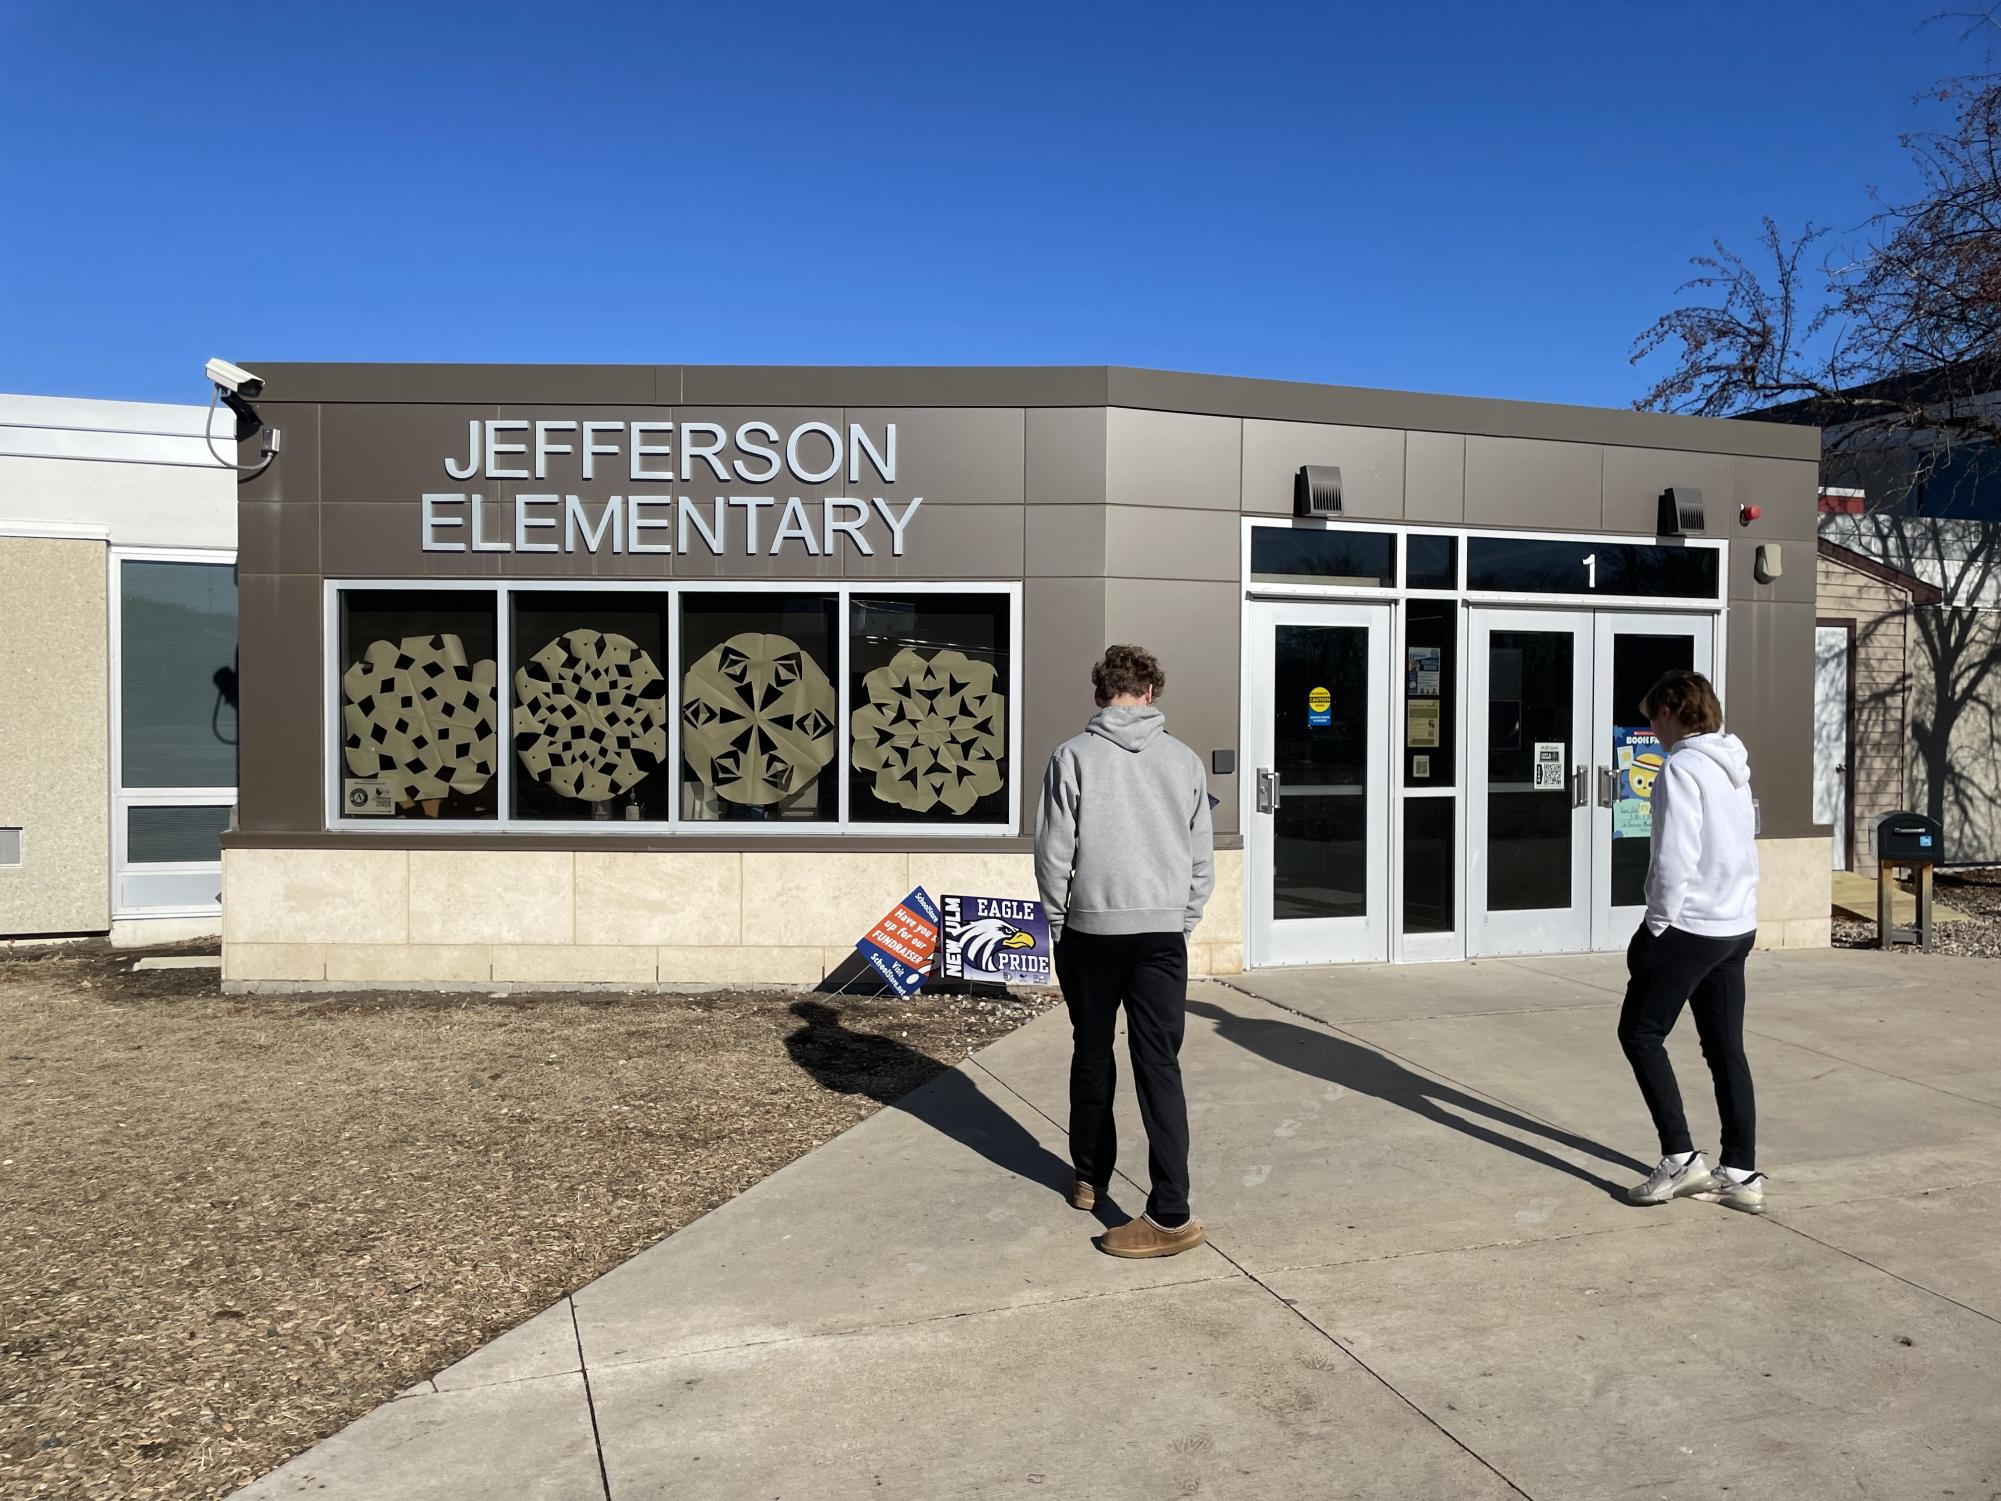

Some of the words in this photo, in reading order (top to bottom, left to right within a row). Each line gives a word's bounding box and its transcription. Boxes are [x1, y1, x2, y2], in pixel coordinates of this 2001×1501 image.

[445, 420, 896, 483] JEFFERSON
[422, 494, 923, 556] ELEMENTARY
[1582, 553, 1595, 588] 1
[1626, 736, 1649, 745] BOOK
[1650, 736, 1660, 745] FA
[894, 908, 917, 927] Have
[913, 924, 933, 938] you
[915, 892, 939, 923] SchoolStore
[945, 897, 961, 936] ULM
[977, 898, 1034, 920] EAGLE
[871, 929, 924, 965] FUNDRAISER
[883, 920, 898, 932] up
[896, 927, 913, 940] for
[911, 939, 927, 949] our
[870, 952, 907, 996] SchoolStore.net
[891, 961, 905, 977] Visit
[945, 939, 963, 978] NEW
[998, 953, 1049, 974] PRIDE
